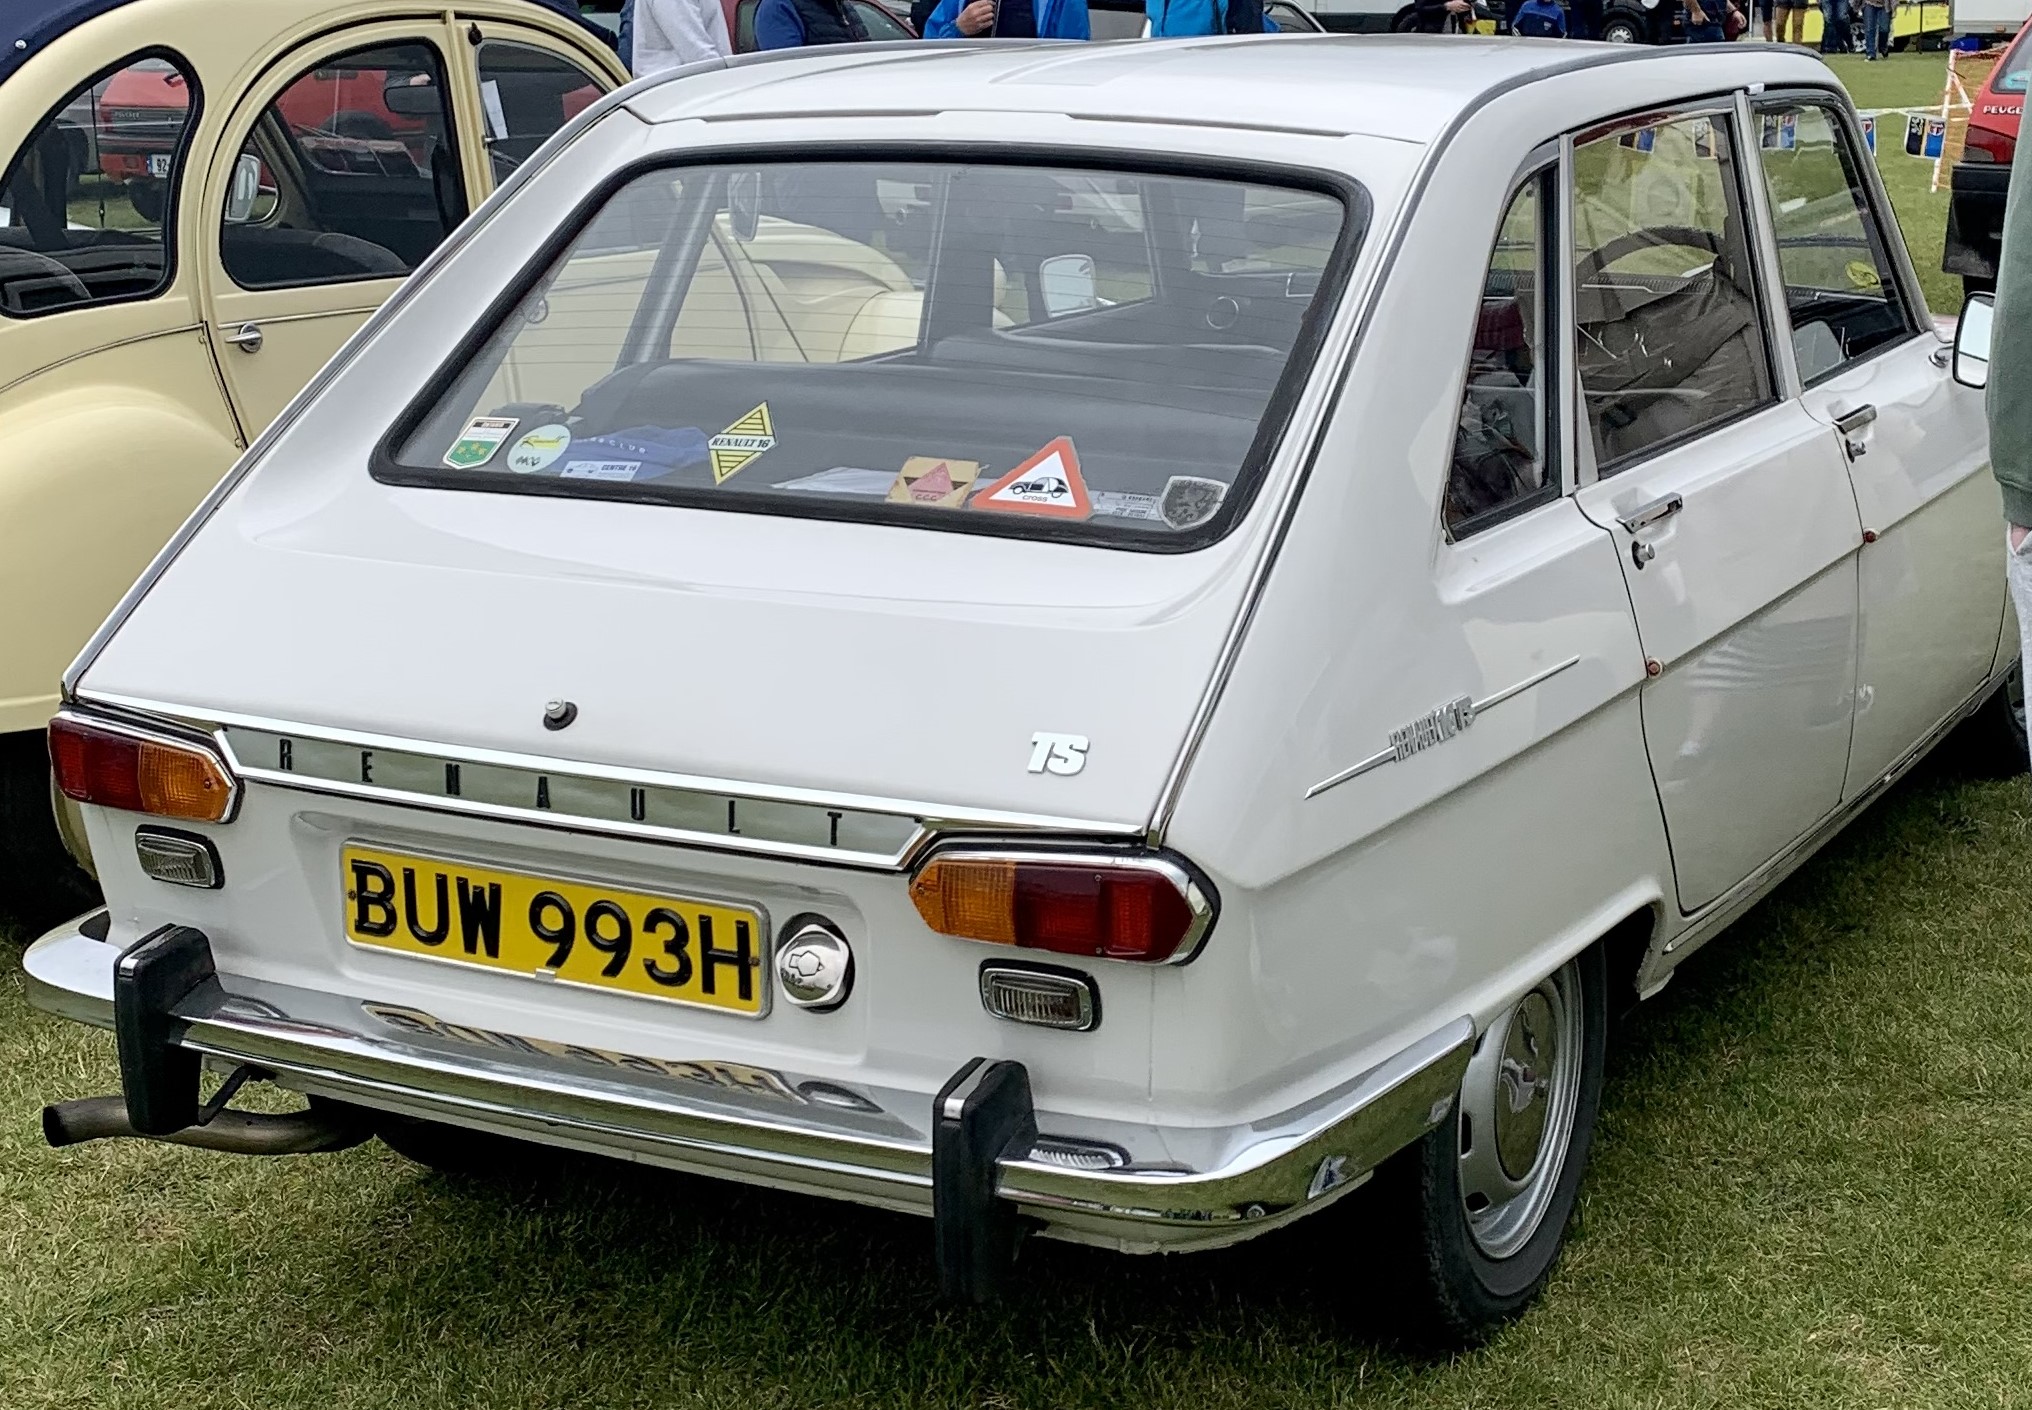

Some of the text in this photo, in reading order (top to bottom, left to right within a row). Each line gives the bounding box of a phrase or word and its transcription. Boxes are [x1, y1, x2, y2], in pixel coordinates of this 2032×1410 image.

[1983, 105, 2023, 115] PEUGE
[711, 437, 771, 448] RENAULT 16
[1027, 731, 1090, 777] TS
[279, 738, 842, 847] RENAULT
[351, 859, 754, 1001] BUW 993H
